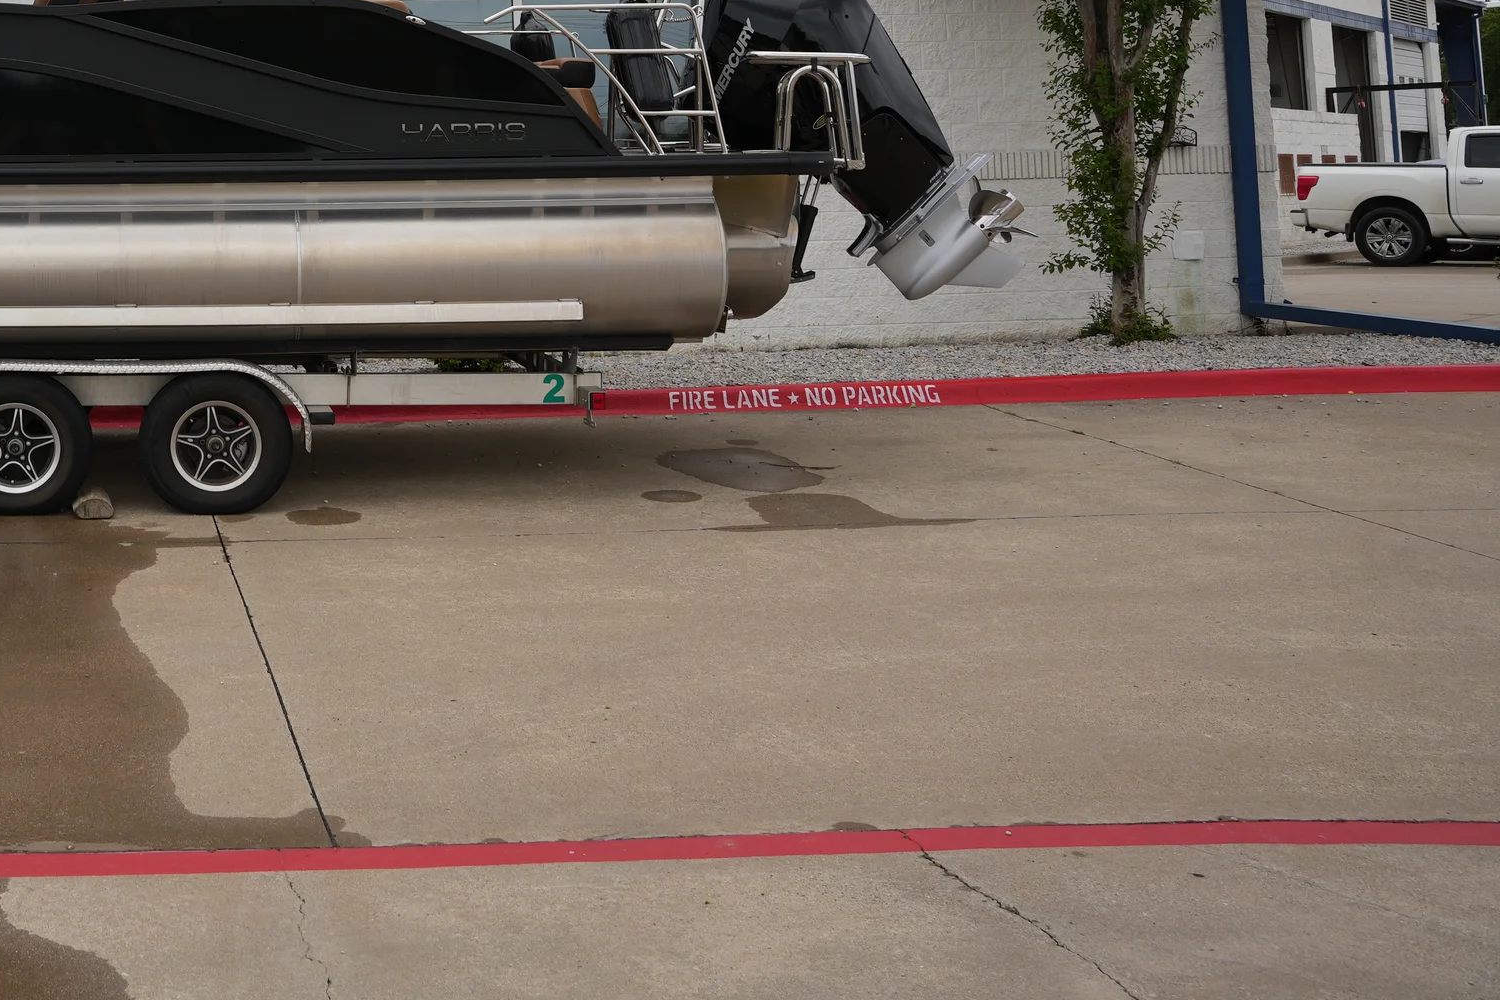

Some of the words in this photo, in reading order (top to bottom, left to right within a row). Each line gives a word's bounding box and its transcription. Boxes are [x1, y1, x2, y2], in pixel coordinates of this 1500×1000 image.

[713, 17, 755, 104] MERCURY
[543, 373, 566, 403] 2
[668, 390, 717, 410] FIRE
[722, 388, 783, 409] LANE
[804, 387, 837, 407] NO
[842, 384, 941, 405] PARKING
